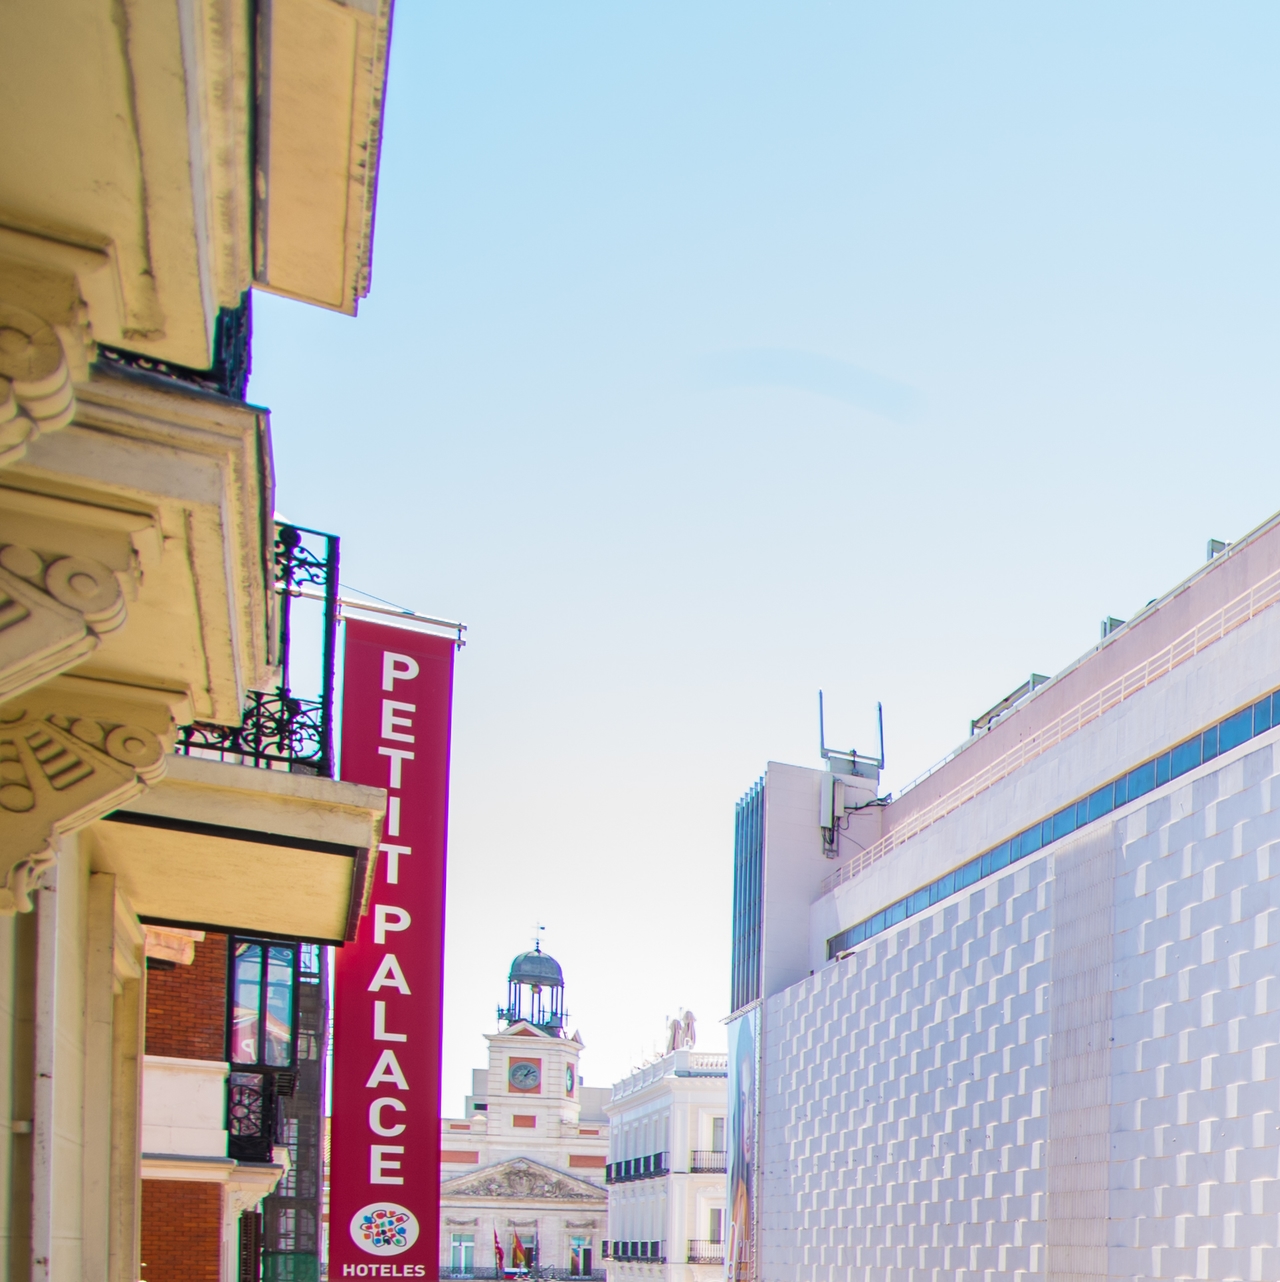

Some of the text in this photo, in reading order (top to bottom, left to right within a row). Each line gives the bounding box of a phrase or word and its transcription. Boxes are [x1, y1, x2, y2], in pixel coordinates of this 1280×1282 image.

[366, 650, 420, 1186] PETIT PALACE
[342, 1263, 426, 1279] HOTELES
